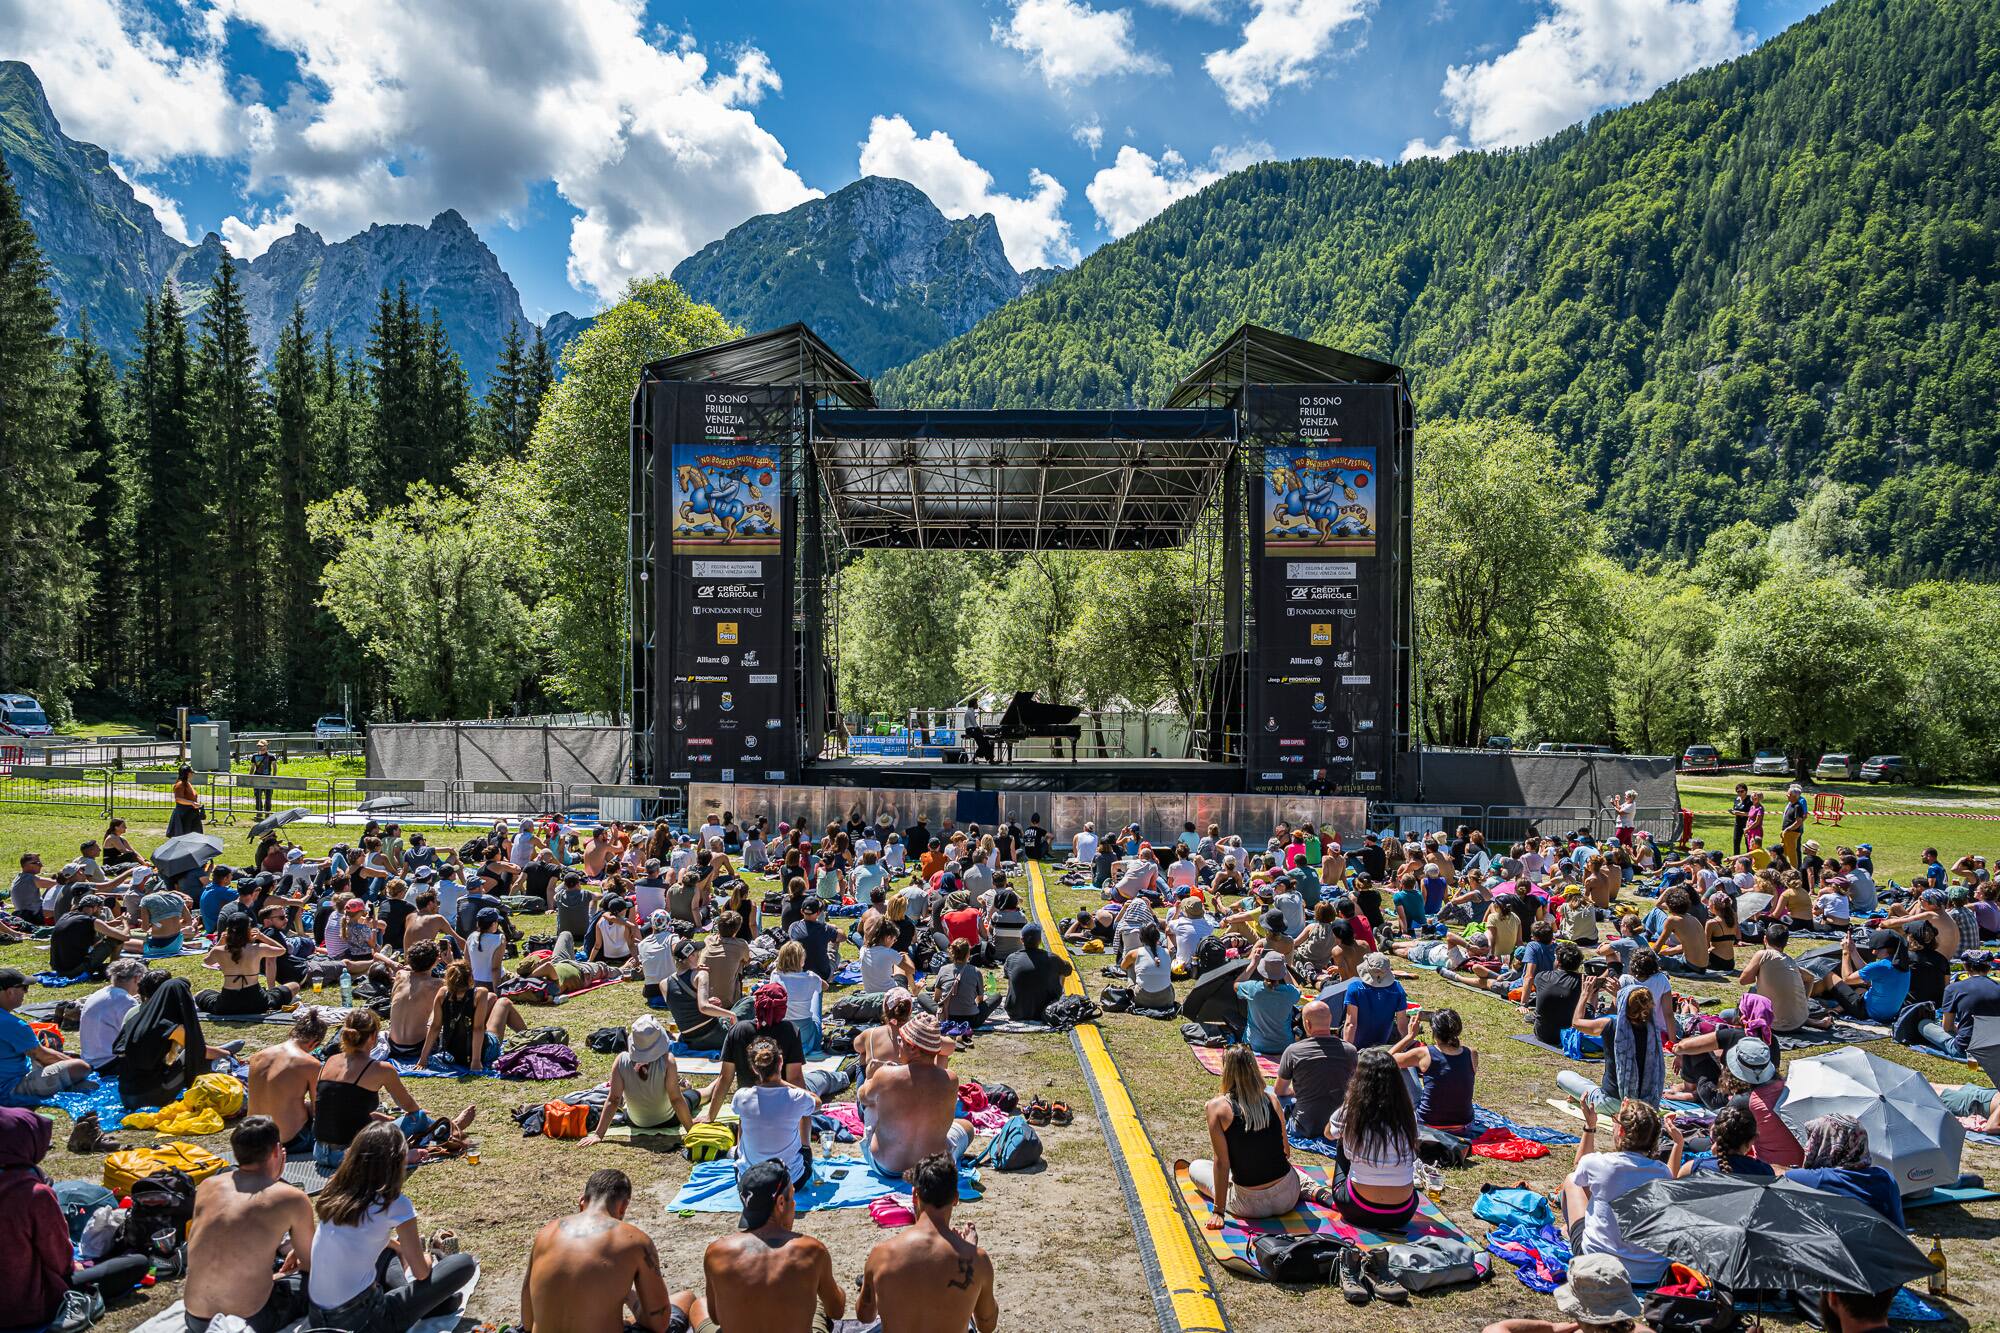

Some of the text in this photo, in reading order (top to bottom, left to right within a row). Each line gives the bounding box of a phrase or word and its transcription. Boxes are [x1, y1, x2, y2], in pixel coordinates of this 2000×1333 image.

[705, 394, 748, 403] IO SONO
[1299, 397, 1342, 406] IO SONO
[705, 404, 731, 413] FRIULI
[1300, 407, 1325, 416] FRIULI
[705, 415, 744, 424] VENEZIA
[1299, 417, 1338, 426] VENEZIA
[705, 425, 736, 434] GIULIA
[1299, 428, 1330, 436] GIULIA
[743, 608, 762, 617] FRIULI
[1337, 608, 1356, 618] FRIULI
[1290, 657, 1313, 665] Allianz
